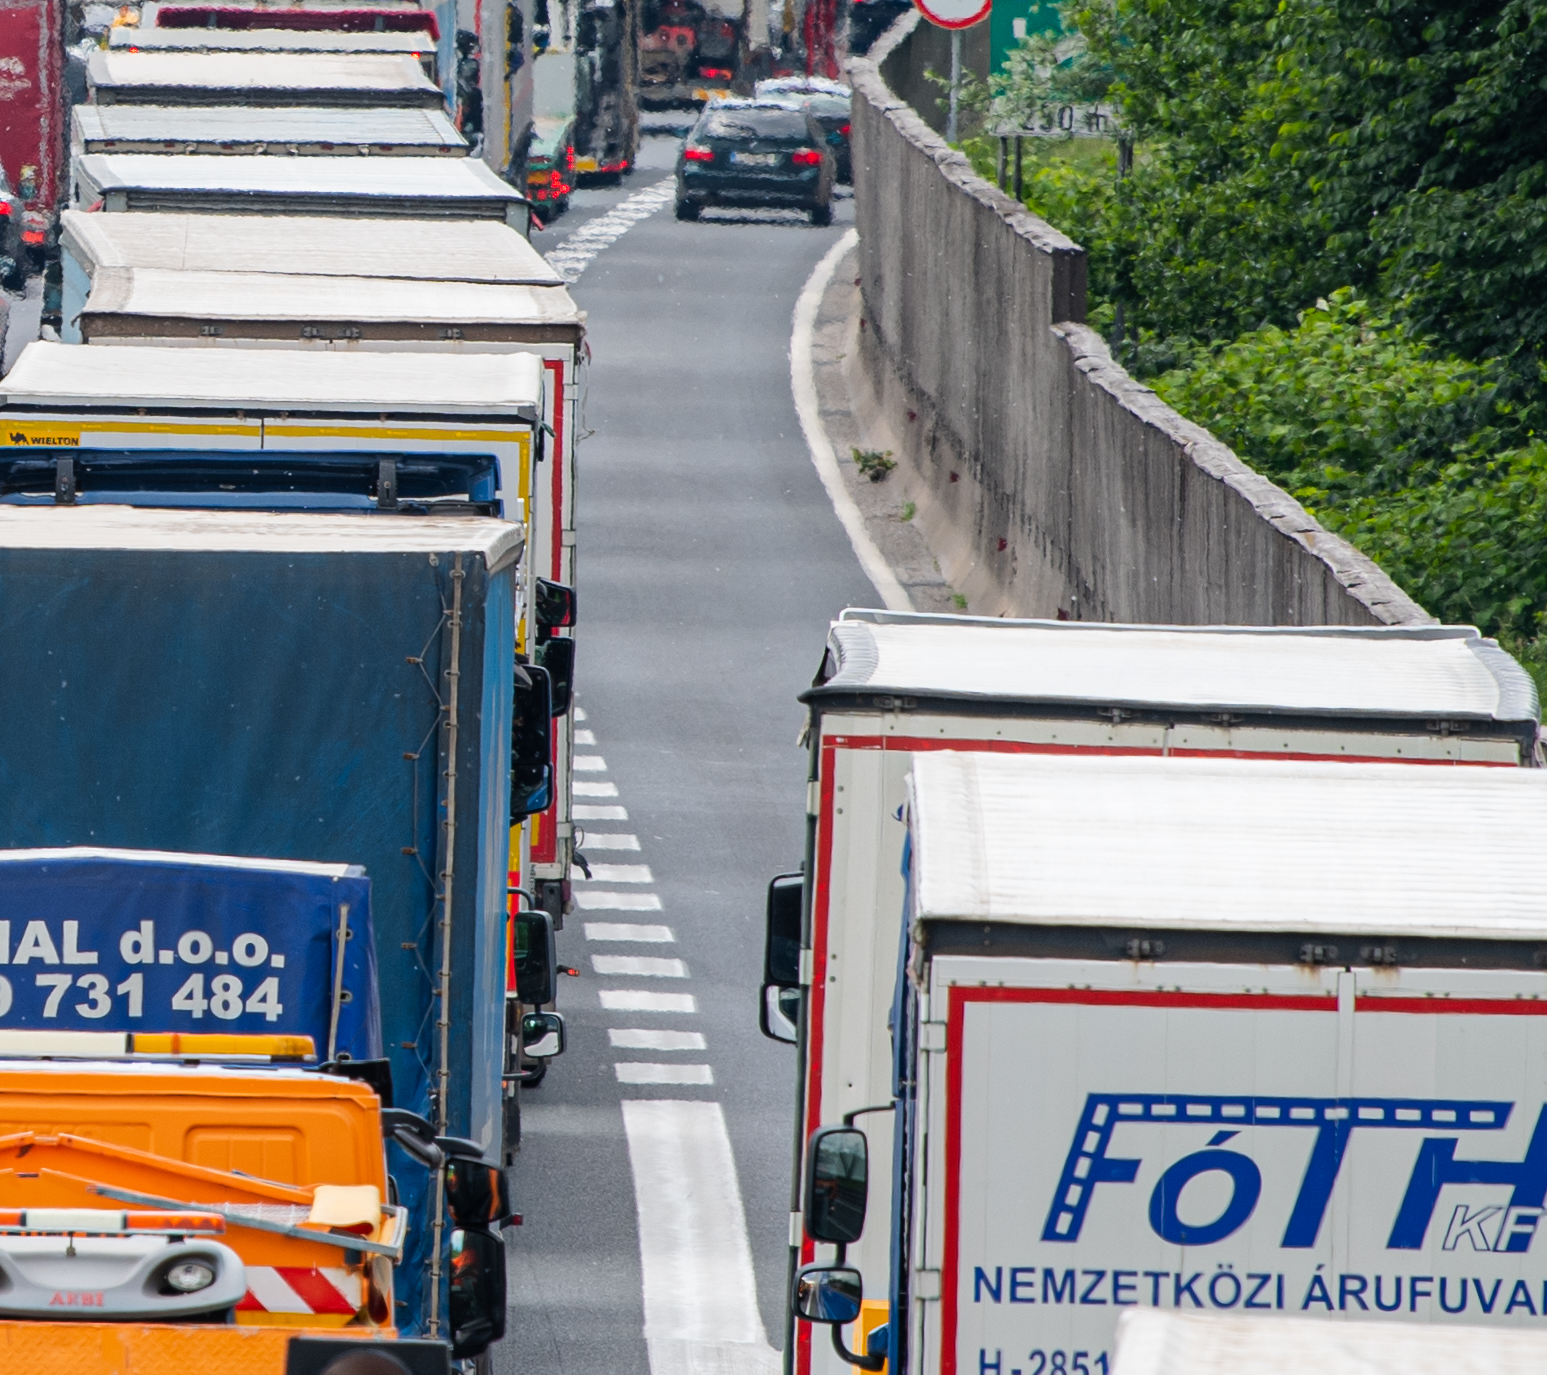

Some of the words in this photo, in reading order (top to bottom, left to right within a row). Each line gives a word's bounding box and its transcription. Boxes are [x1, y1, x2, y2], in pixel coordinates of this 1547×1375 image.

[30, 436, 80, 446] WIELTON
[119, 920, 285, 968] d.o.o.
[35, 972, 144, 1018] 731
[171, 973, 283, 1021] 484
[973, 1265, 1285, 1311] NEMZETKÖZI
